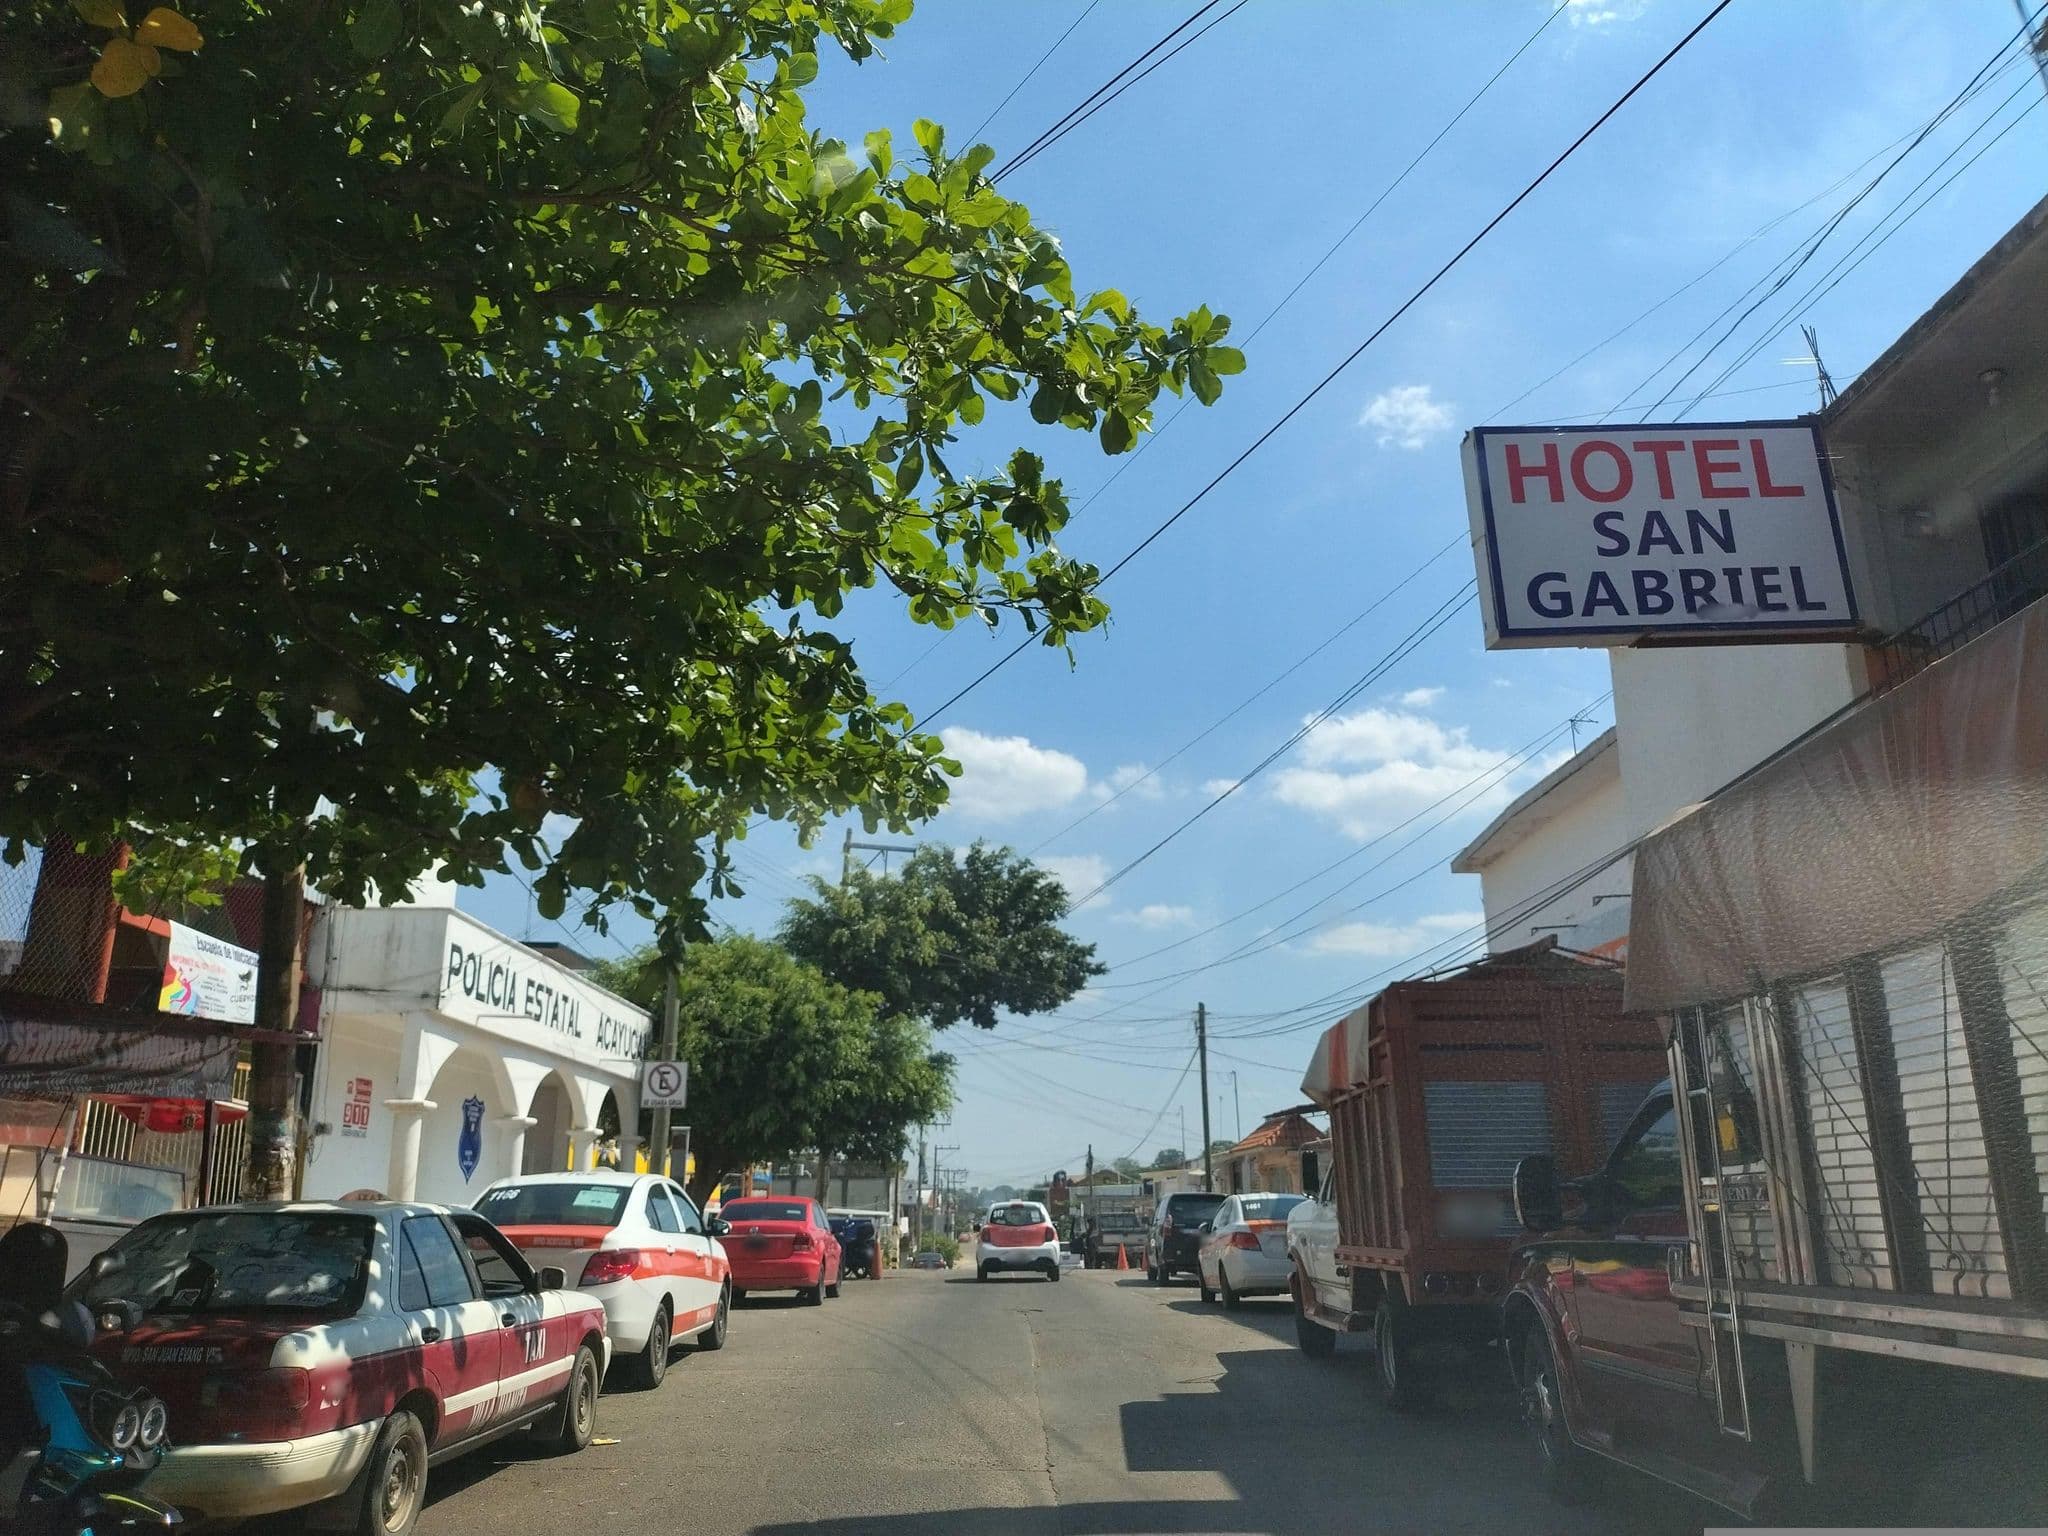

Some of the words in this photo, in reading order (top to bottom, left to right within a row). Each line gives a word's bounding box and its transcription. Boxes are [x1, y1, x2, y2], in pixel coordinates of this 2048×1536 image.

[1504, 438, 1805, 503] HOTEL
[1592, 509, 1737, 557] SAN
[1526, 566, 1827, 618] GABRIEL
[447, 943, 517, 1013] POLICÍA
[525, 978, 582, 1038] ESTATAL
[344, 1103, 369, 1125] 911
[525, 1328, 546, 1363] TAXI
